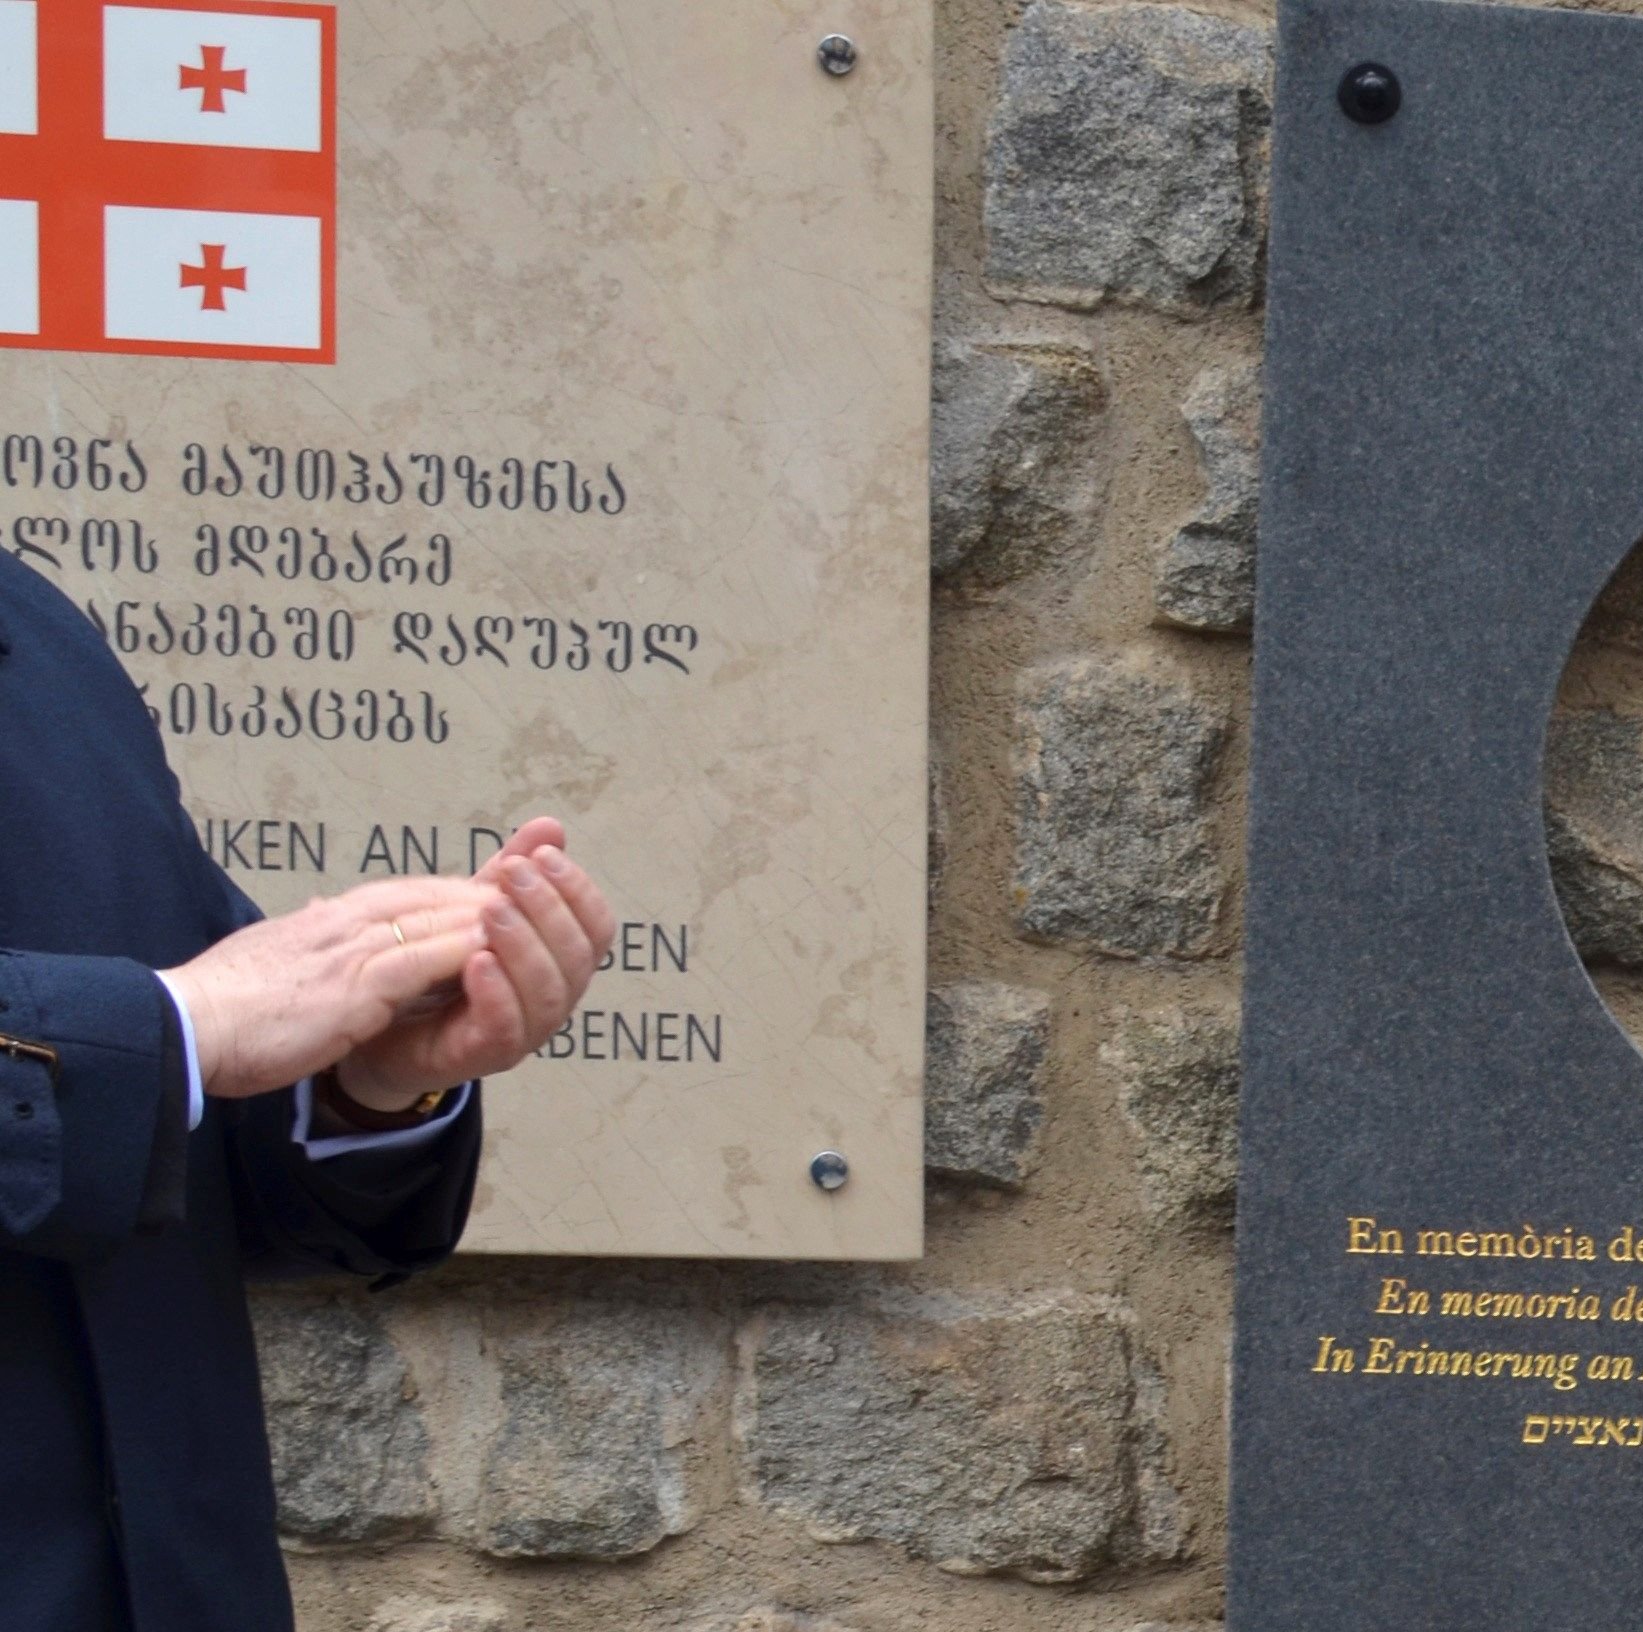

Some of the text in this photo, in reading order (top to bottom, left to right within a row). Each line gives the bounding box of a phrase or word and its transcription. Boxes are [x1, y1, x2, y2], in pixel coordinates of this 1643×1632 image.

[0, 516, 453, 587] ლოს მდებარე
[393, 610, 700, 675] დაღუპულ
[359, 824, 438, 875] AN
[534, 1010, 722, 1063] BENEN
[1348, 1216, 1404, 1255] En
[1417, 1223, 1596, 1261] memòria
[1376, 1277, 1430, 1315] En
[1441, 1286, 1600, 1321] memoria
[1313, 1335, 1354, 1373] In
[1363, 1336, 1580, 1391] Erinnerung
[1587, 1355, 1633, 1381] an
